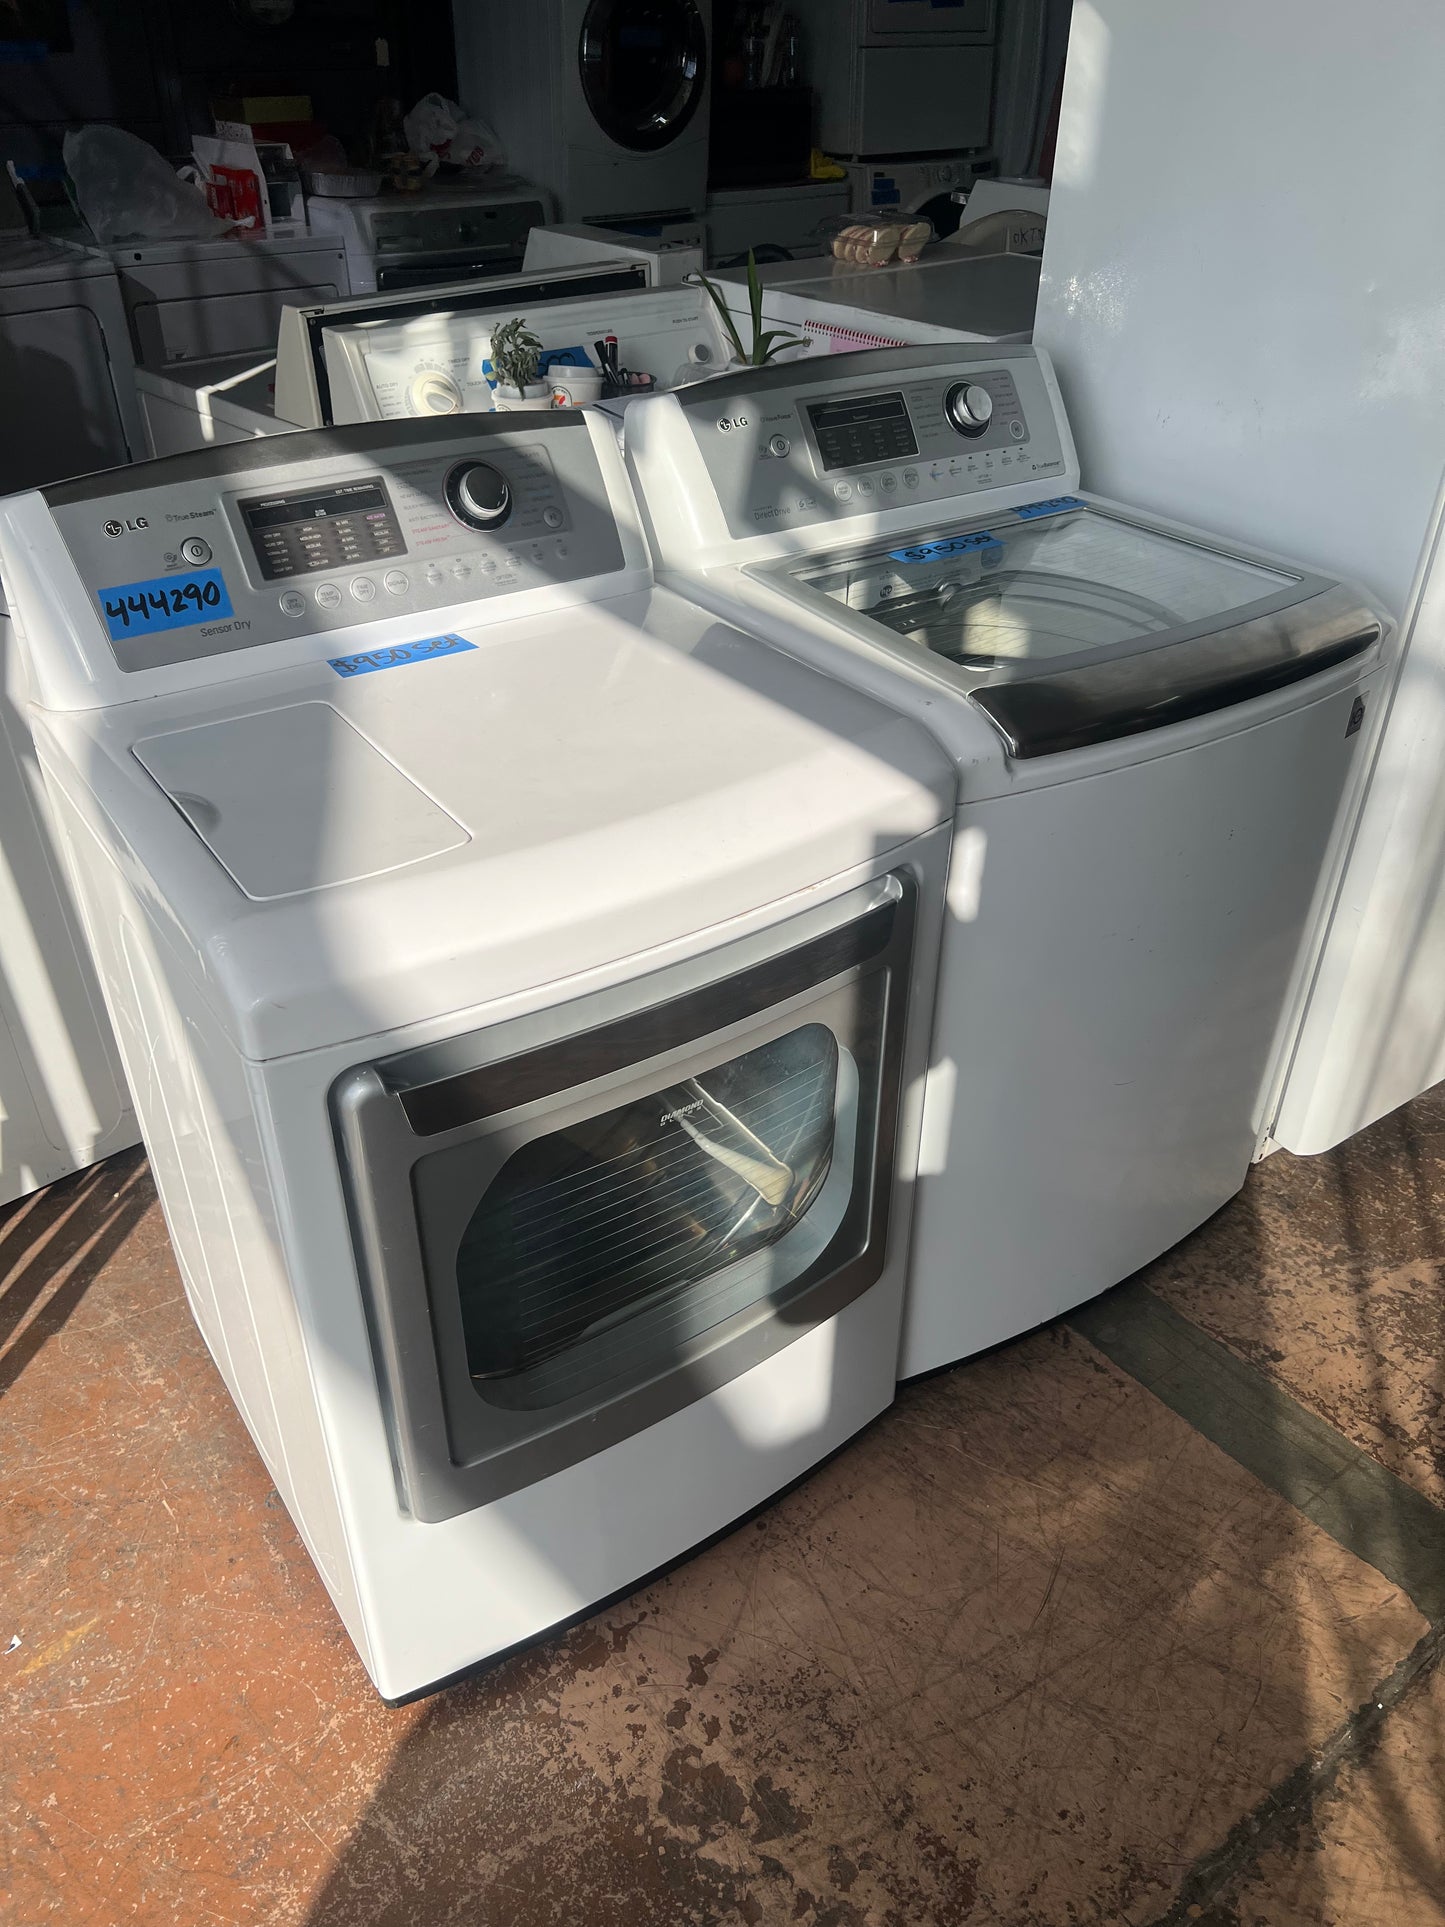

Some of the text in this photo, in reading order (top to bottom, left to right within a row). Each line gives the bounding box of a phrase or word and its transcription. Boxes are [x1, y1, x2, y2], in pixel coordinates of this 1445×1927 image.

[733, 417, 748, 428] LG
[125, 517, 149, 532] LG
[904, 541, 966, 560] $950
[105, 580, 221, 627] 444290
[200, 620, 252, 638] Sensor Dry
[333, 648, 412, 674] $950
[660, 1099, 704, 1123] DIAMOND
